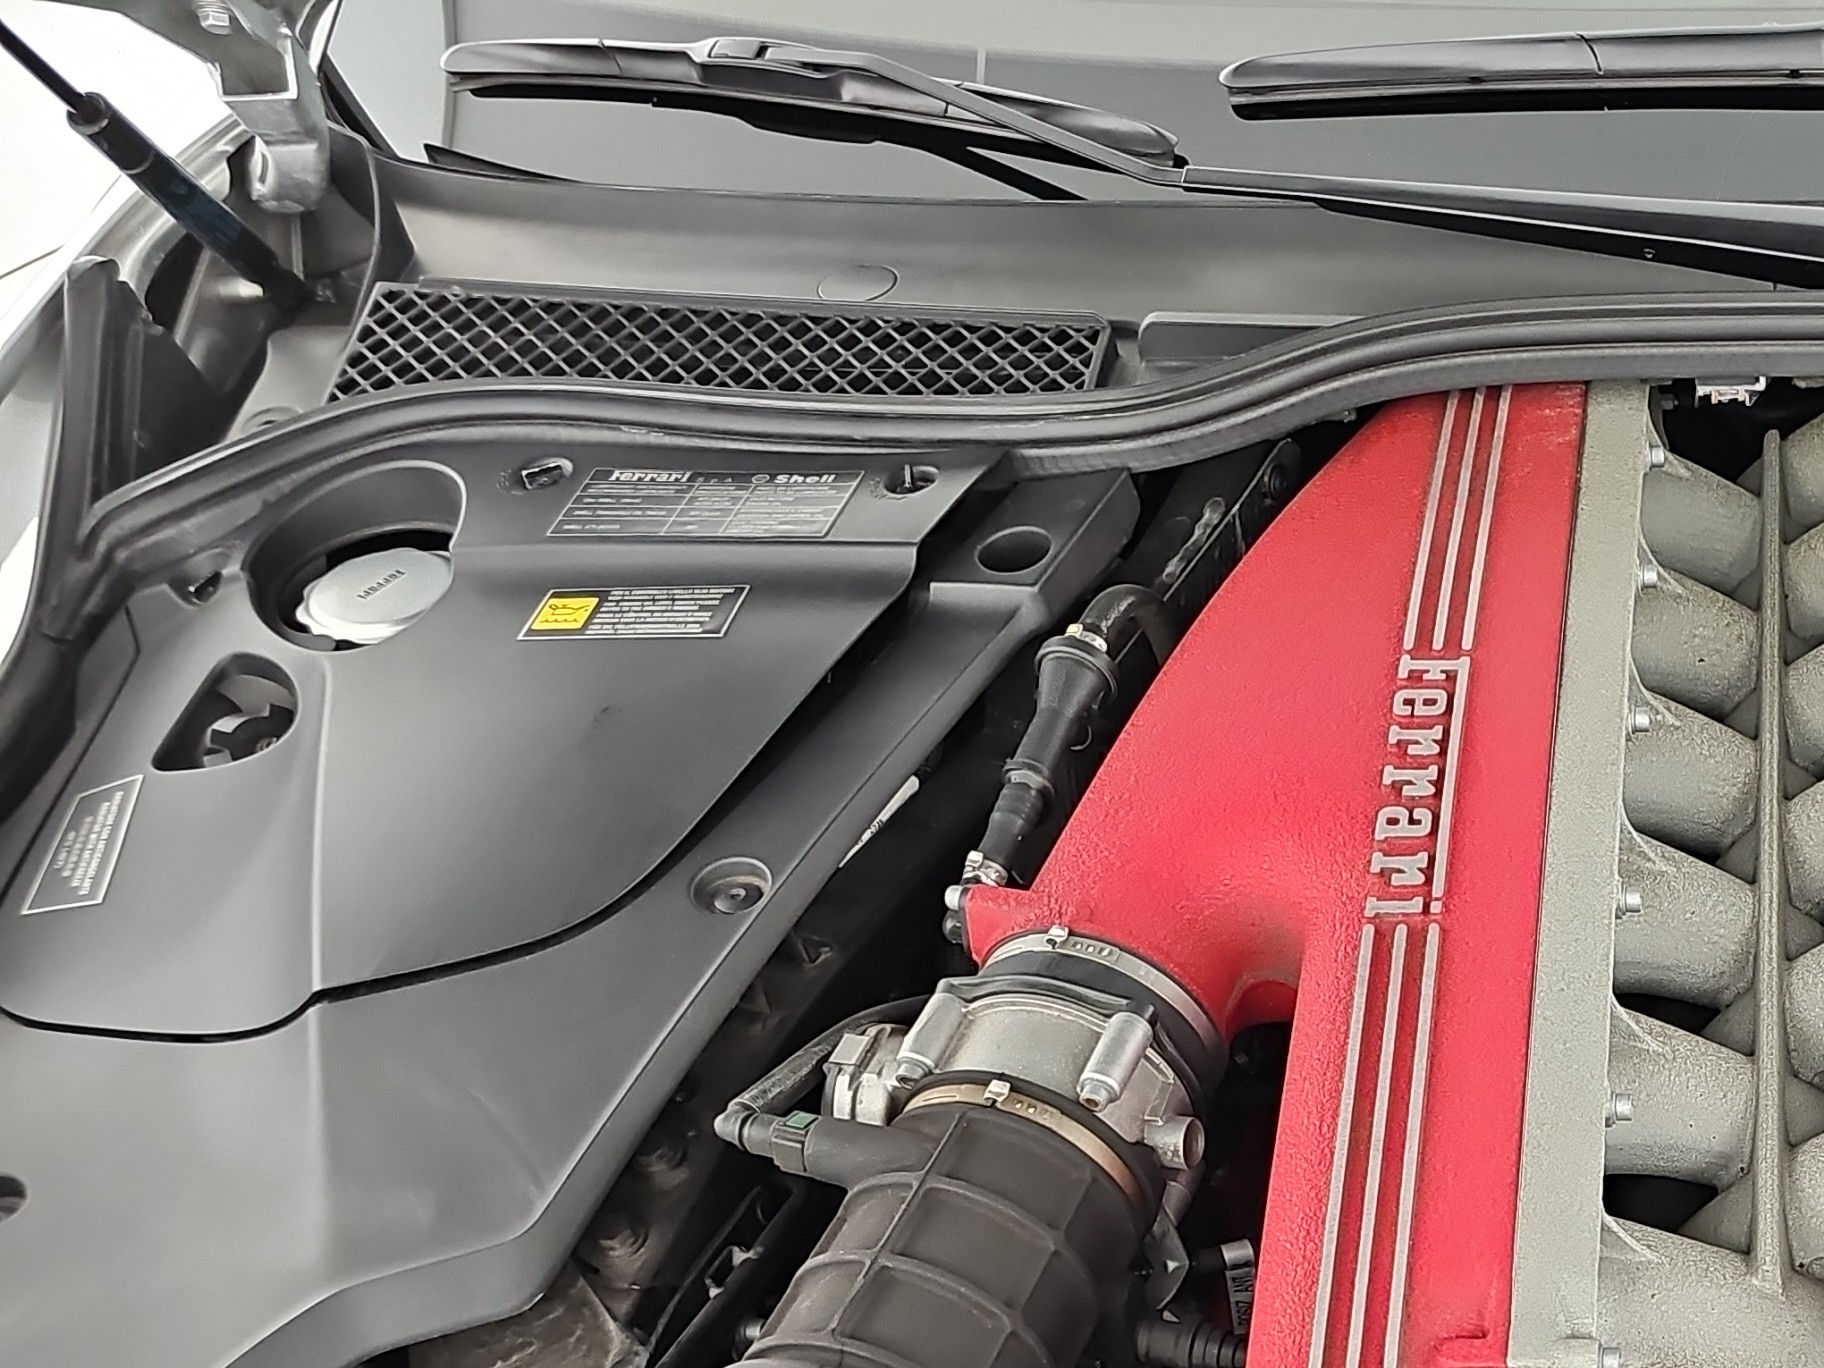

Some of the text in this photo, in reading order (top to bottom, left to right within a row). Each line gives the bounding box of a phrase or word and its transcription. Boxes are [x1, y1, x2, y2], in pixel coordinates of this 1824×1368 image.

[608, 470, 691, 482] Ferrari
[774, 474, 836, 483] Shell
[356, 569, 406, 599] Ferrari
[1364, 652, 1470, 919] Ferrari
